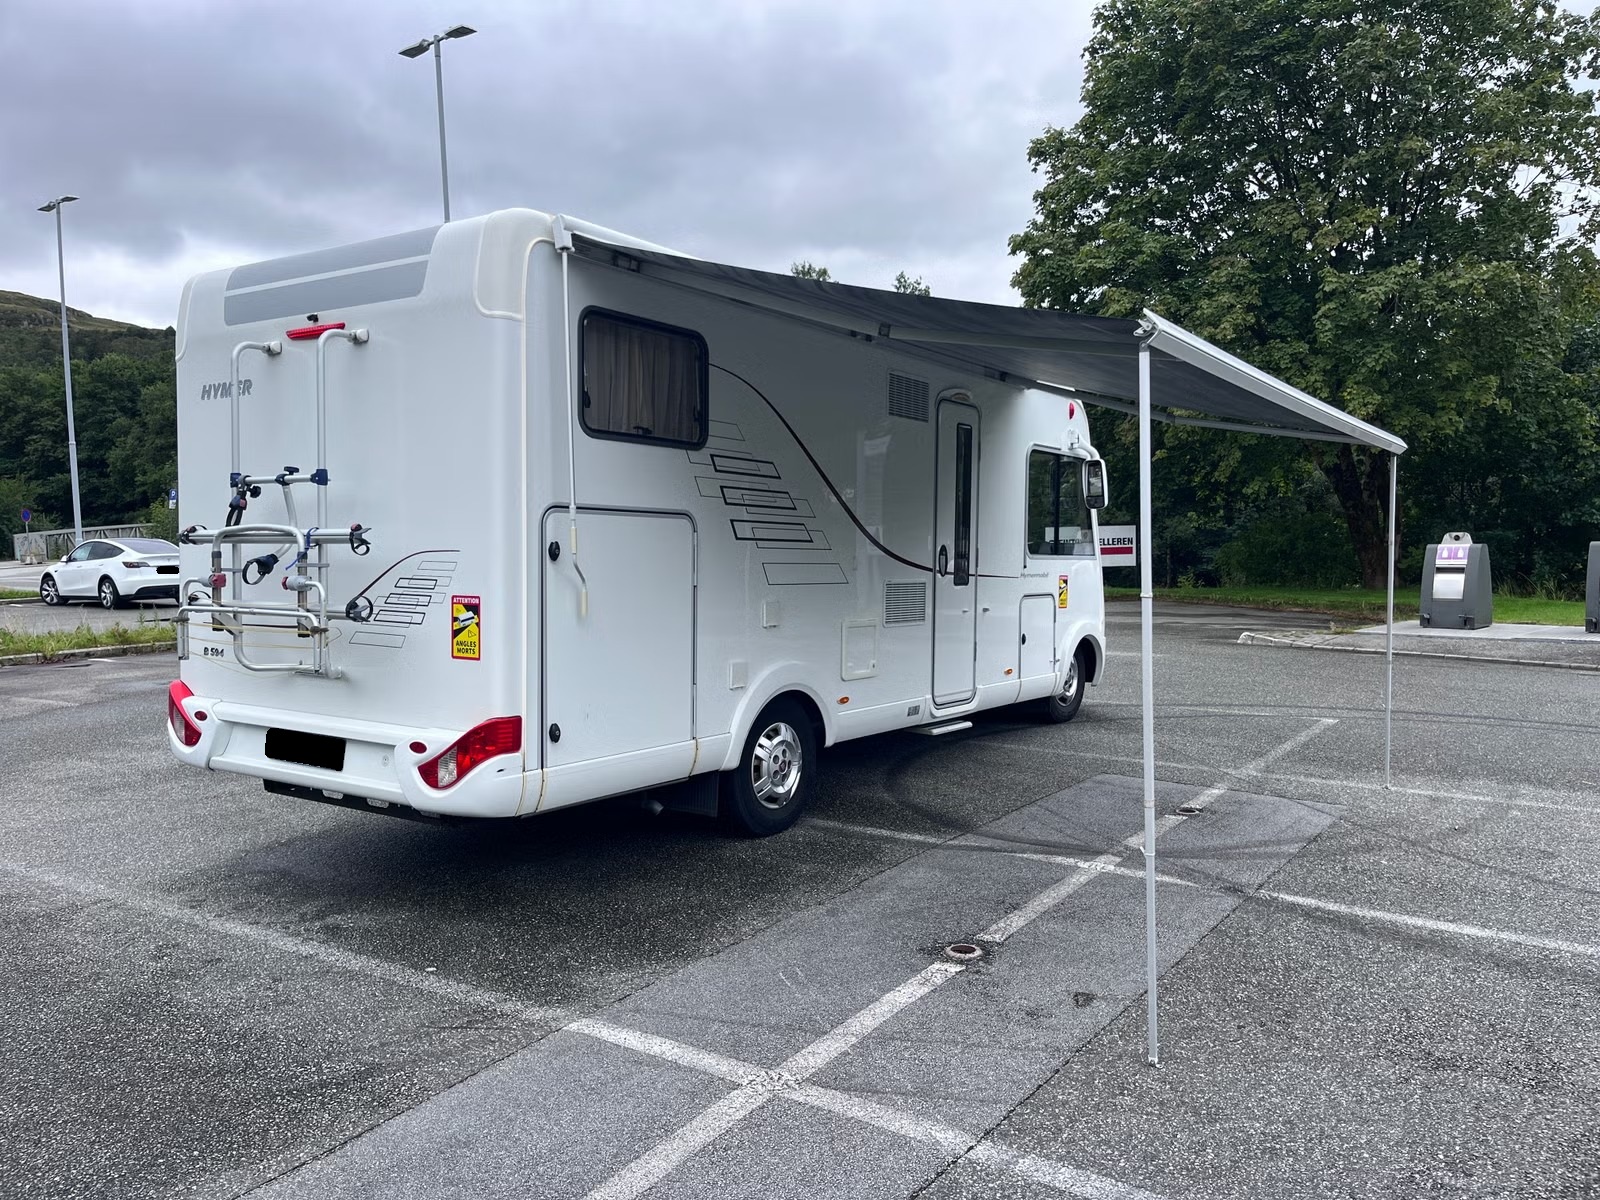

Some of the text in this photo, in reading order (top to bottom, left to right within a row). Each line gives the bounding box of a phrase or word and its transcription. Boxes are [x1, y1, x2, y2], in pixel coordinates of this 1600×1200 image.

[455, 640, 477, 648] ANGLES
[203, 646, 210, 656] B
[456, 647, 476, 655] MORTS
